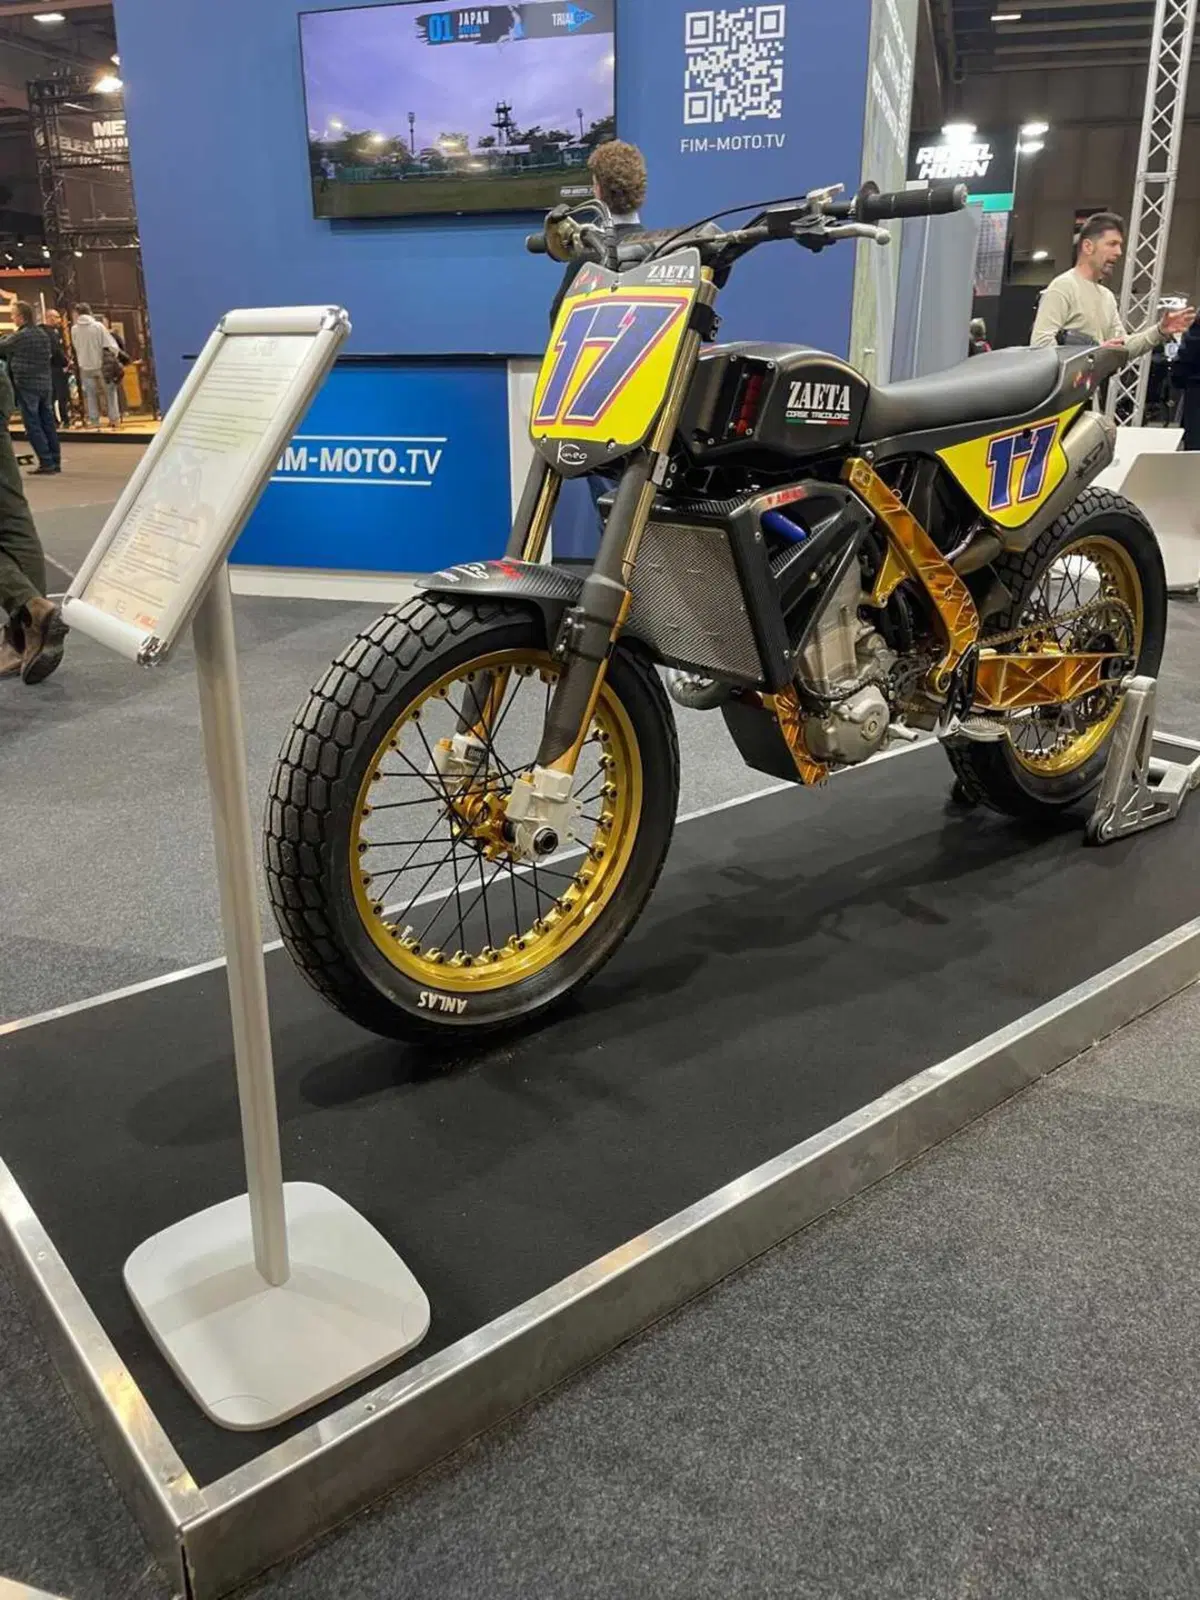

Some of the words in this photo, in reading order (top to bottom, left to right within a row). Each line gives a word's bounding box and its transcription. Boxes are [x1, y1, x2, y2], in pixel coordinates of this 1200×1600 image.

[428, 14, 454, 42] 01
[459, 11, 489, 25] JAPAN
[680, 133, 786, 153] FIM-MOTO.TV
[647, 264, 695, 279] ZAETA
[534, 295, 689, 427] 17
[787, 381, 851, 411] ZAETA
[986, 417, 1060, 512] 17
[417, 991, 468, 1014] ANLAS
